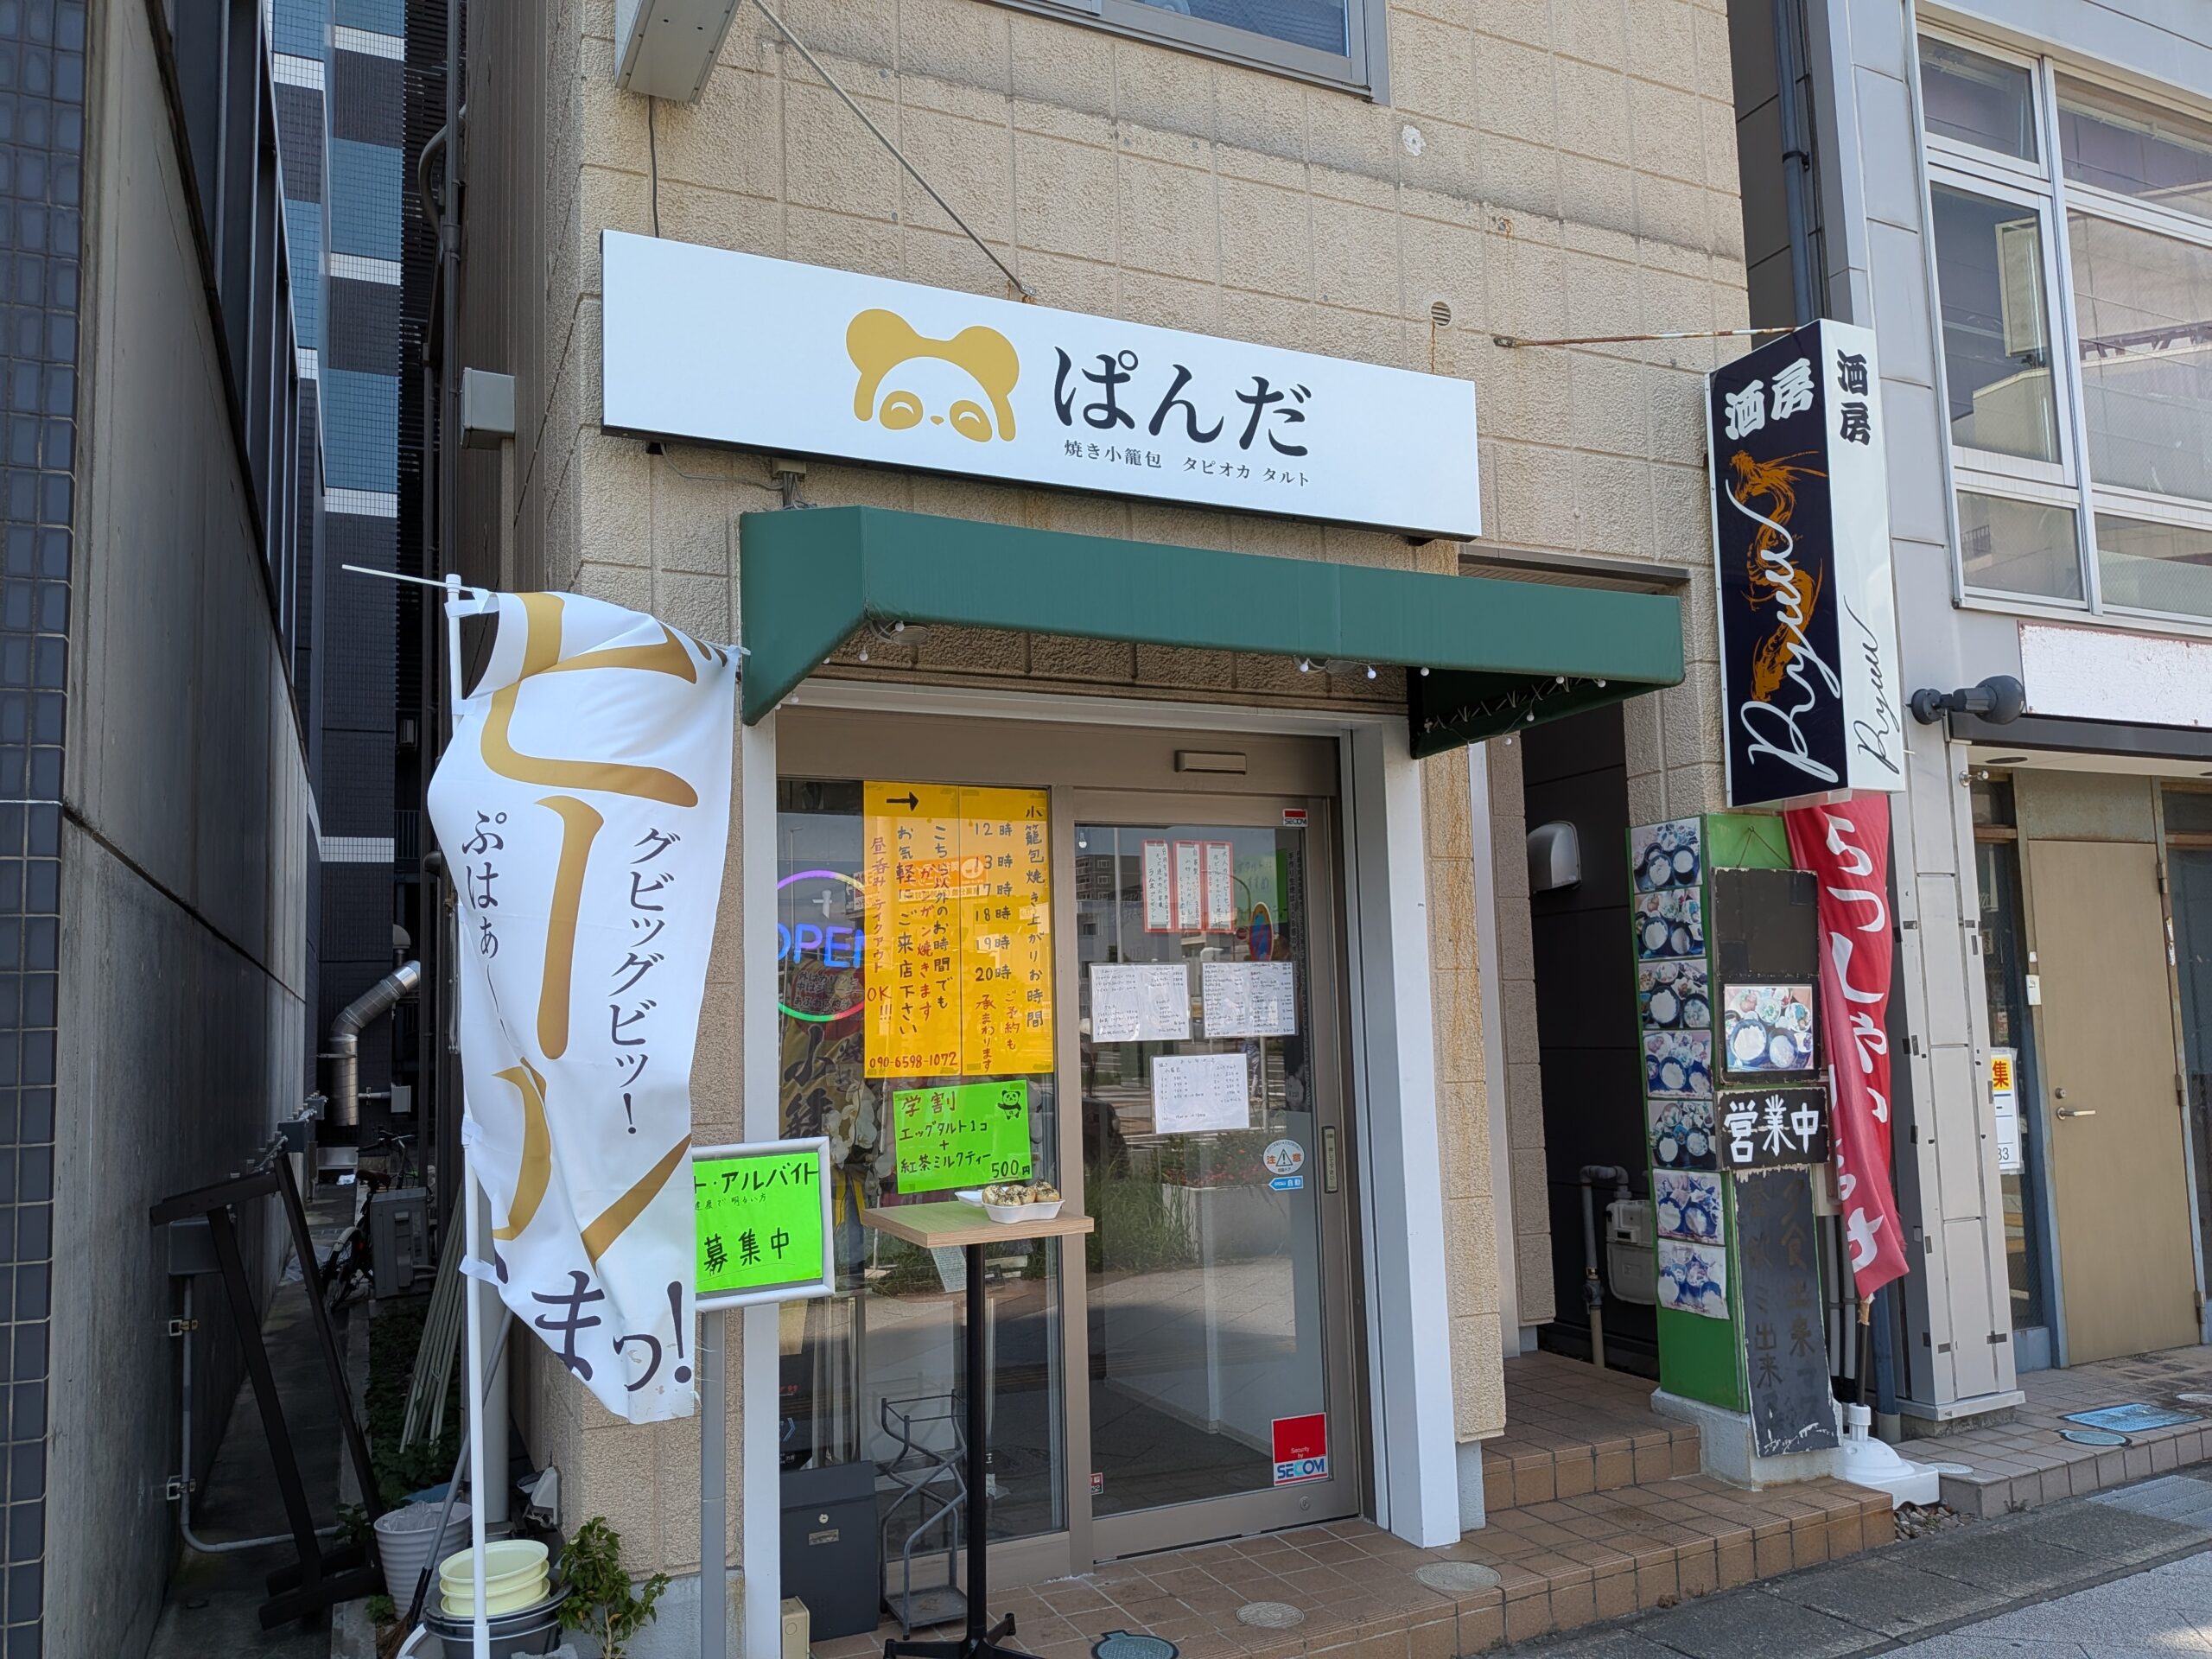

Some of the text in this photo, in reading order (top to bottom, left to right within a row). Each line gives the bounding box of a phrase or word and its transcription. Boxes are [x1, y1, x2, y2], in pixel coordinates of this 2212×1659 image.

[1052, 346, 1312, 457] ぱんだ
[1725, 358, 1815, 441] 酒房
[1836, 348, 1872, 447] 酒房
[1064, 438, 1310, 487] 焼き小籠包 タピオカ タルト
[1026, 805, 1046, 1028] 小籠包焼き上がりお時間
[869, 1052, 958, 1069] 090-6598-1072
[1992, 1060, 2009, 1088] 集
[901, 1090, 957, 1117] 学割
[1724, 1095, 1819, 1163] 営業中
[900, 1151, 992, 1174] 紅茶ミルクティー
[990, 1159, 1031, 1179] 500円
[704, 1227, 791, 1274] 募集中
[494, 1249, 693, 1393] まっ！
[1277, 1459, 1325, 1479] SECOM
